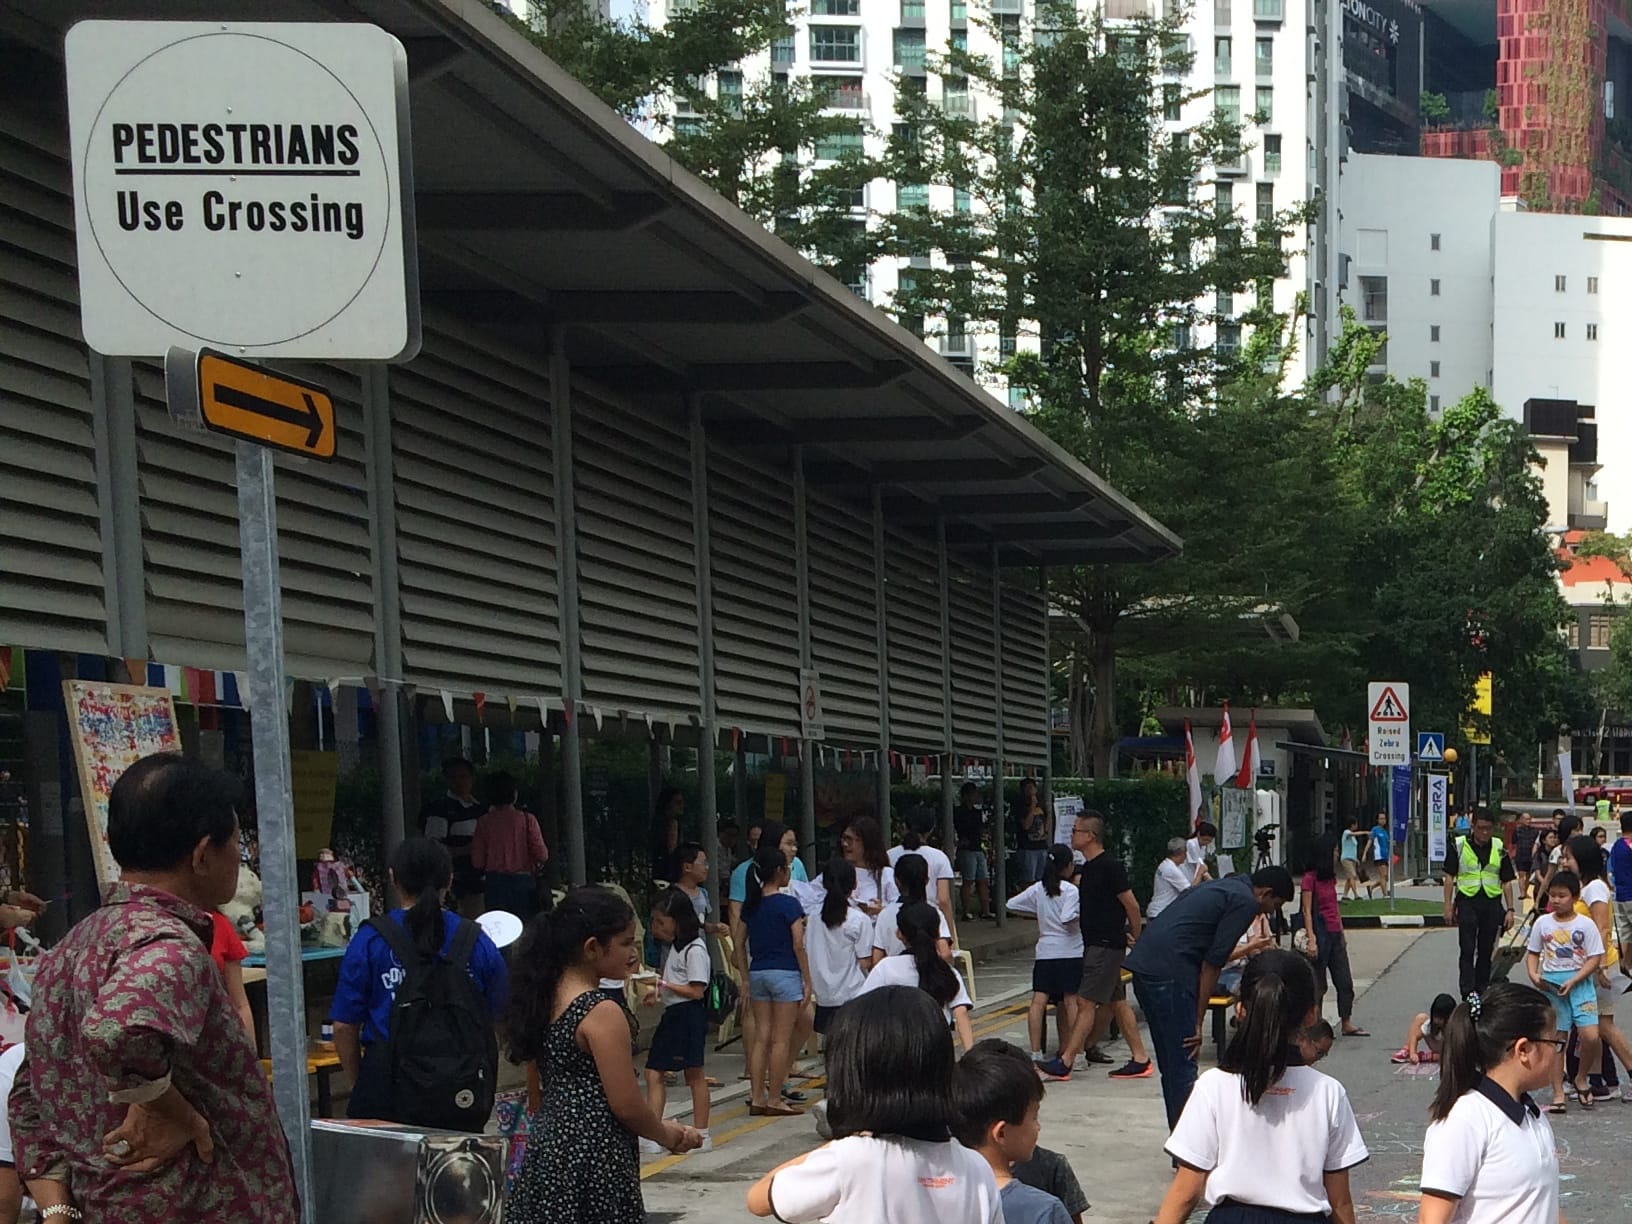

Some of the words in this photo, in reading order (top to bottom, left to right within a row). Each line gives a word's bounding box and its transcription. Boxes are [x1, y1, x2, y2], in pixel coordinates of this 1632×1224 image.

[112, 123, 360, 165] PEDESTRIANS
[116, 191, 184, 231] Use
[203, 190, 365, 240] Crossing
[1377, 726, 1402, 735] Raised
[1379, 739, 1400, 748] Zebra
[1374, 752, 1405, 762] Crossing
[1432, 780, 1443, 832] TERRA
